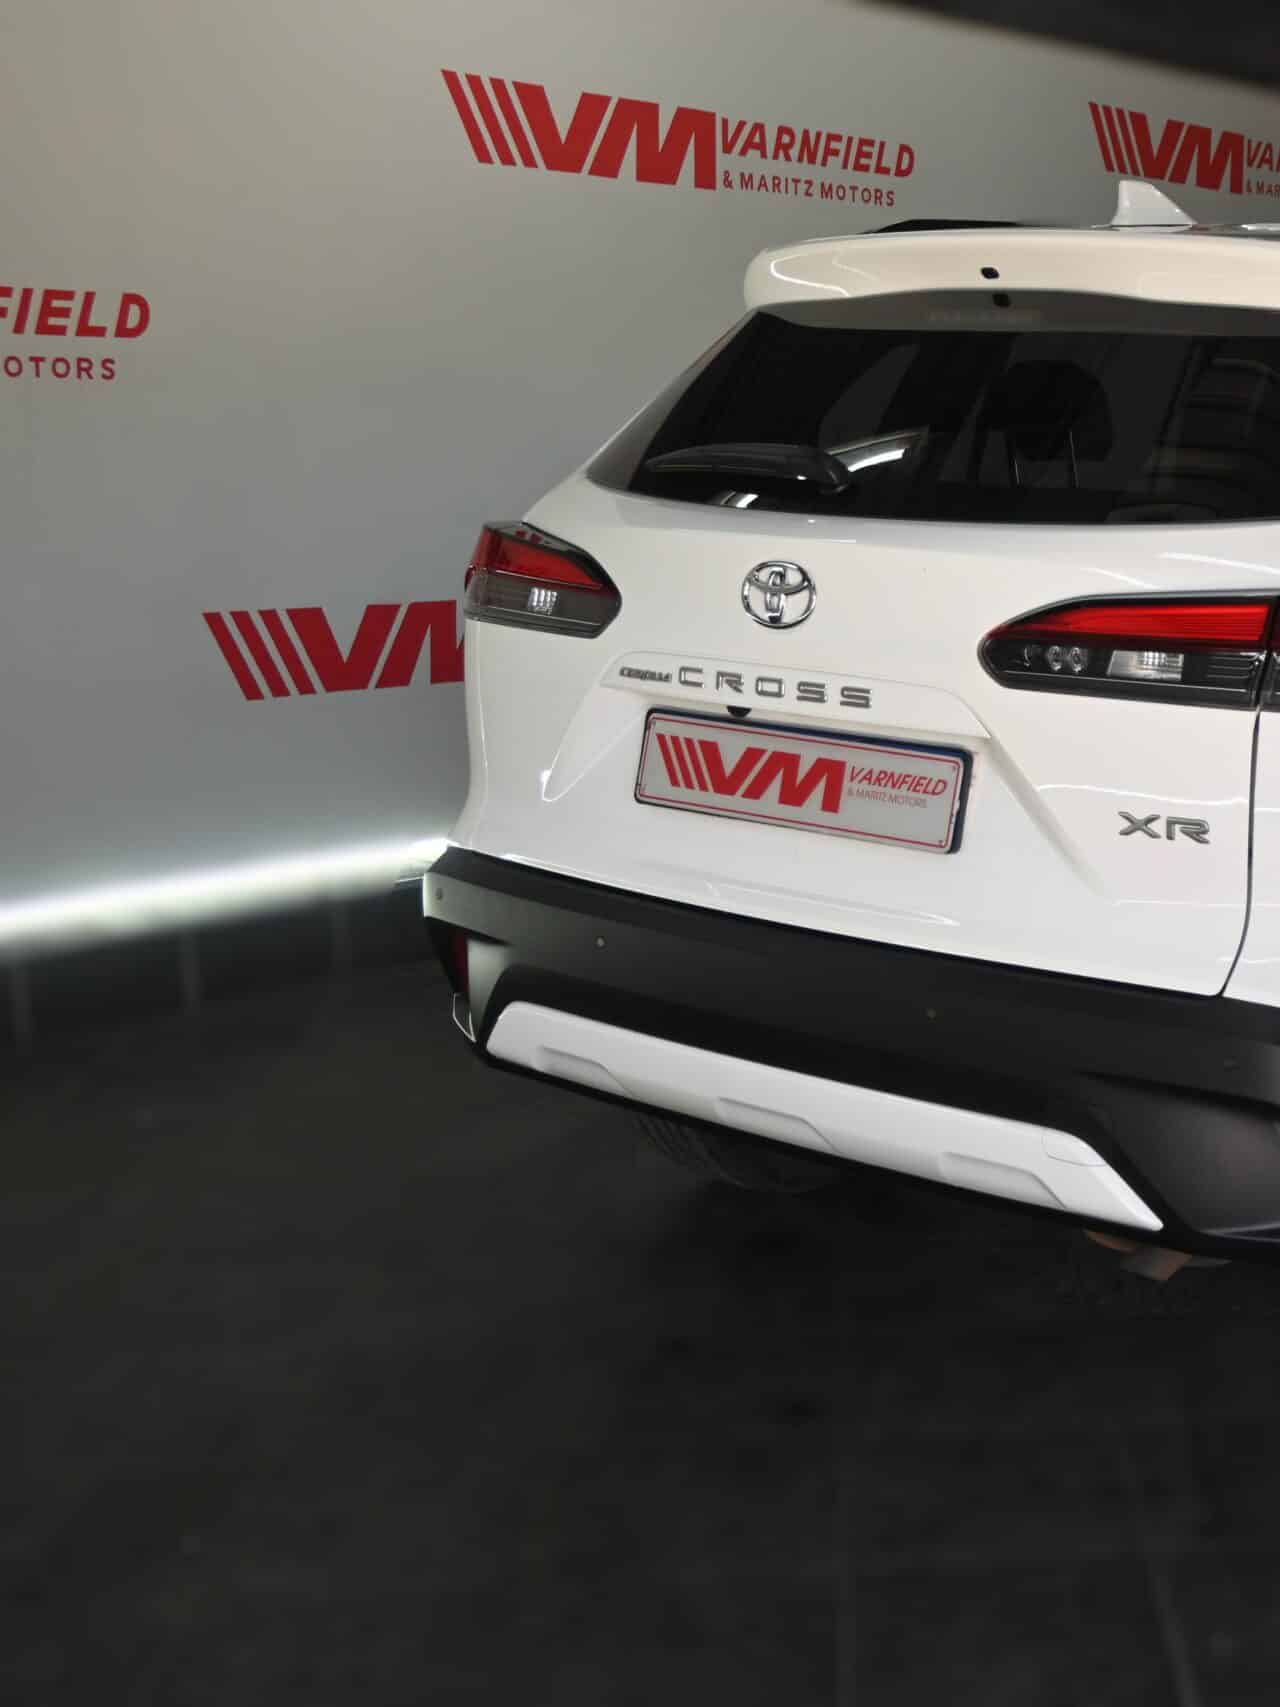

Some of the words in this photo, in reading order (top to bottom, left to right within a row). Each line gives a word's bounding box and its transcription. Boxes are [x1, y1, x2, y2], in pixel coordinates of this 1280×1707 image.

[512, 80, 716, 190] VM
[721, 117, 915, 178] VARNFIELD
[1128, 110, 1244, 194] VM
[723, 170, 733, 190] &
[740, 172, 814, 197] MARITZ
[820, 181, 895, 207] MOTORS
[678, 666, 873, 709] CROSS
[849, 766, 948, 796] VARNFIELD
[1118, 811, 1210, 844] XR
